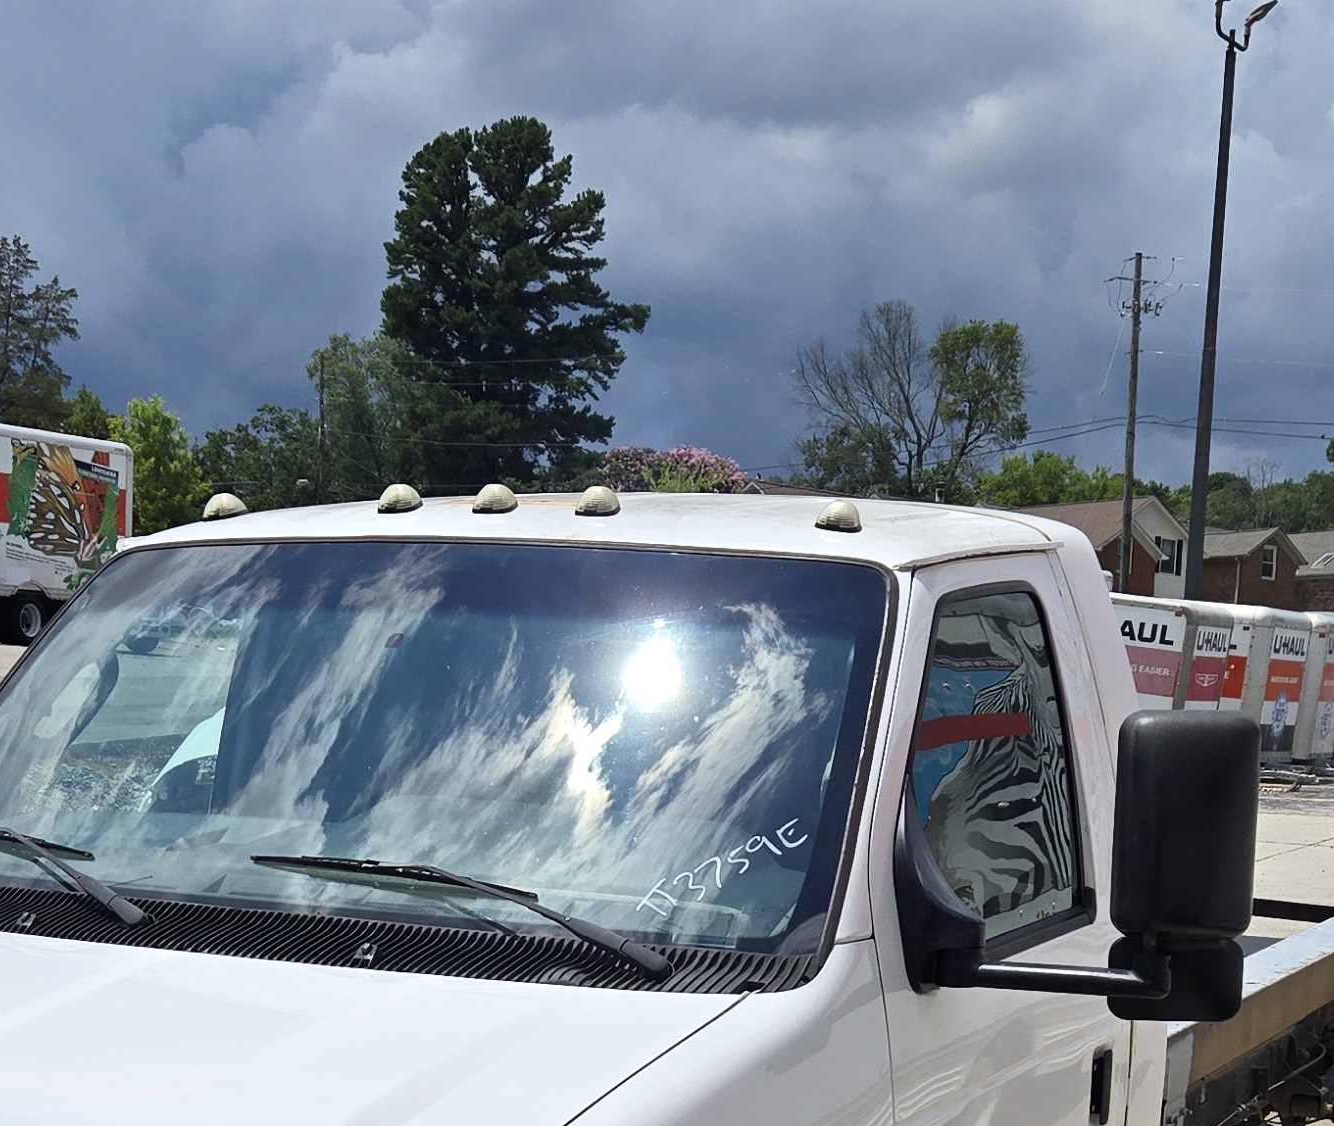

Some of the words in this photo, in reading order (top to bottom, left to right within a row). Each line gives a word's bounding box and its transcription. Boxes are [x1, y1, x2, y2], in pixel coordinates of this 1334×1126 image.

[1196, 630, 1228, 653] U-HAUL
[1273, 633, 1306, 657] U-HAUL
[1139, 665, 1170, 677] EASIER
